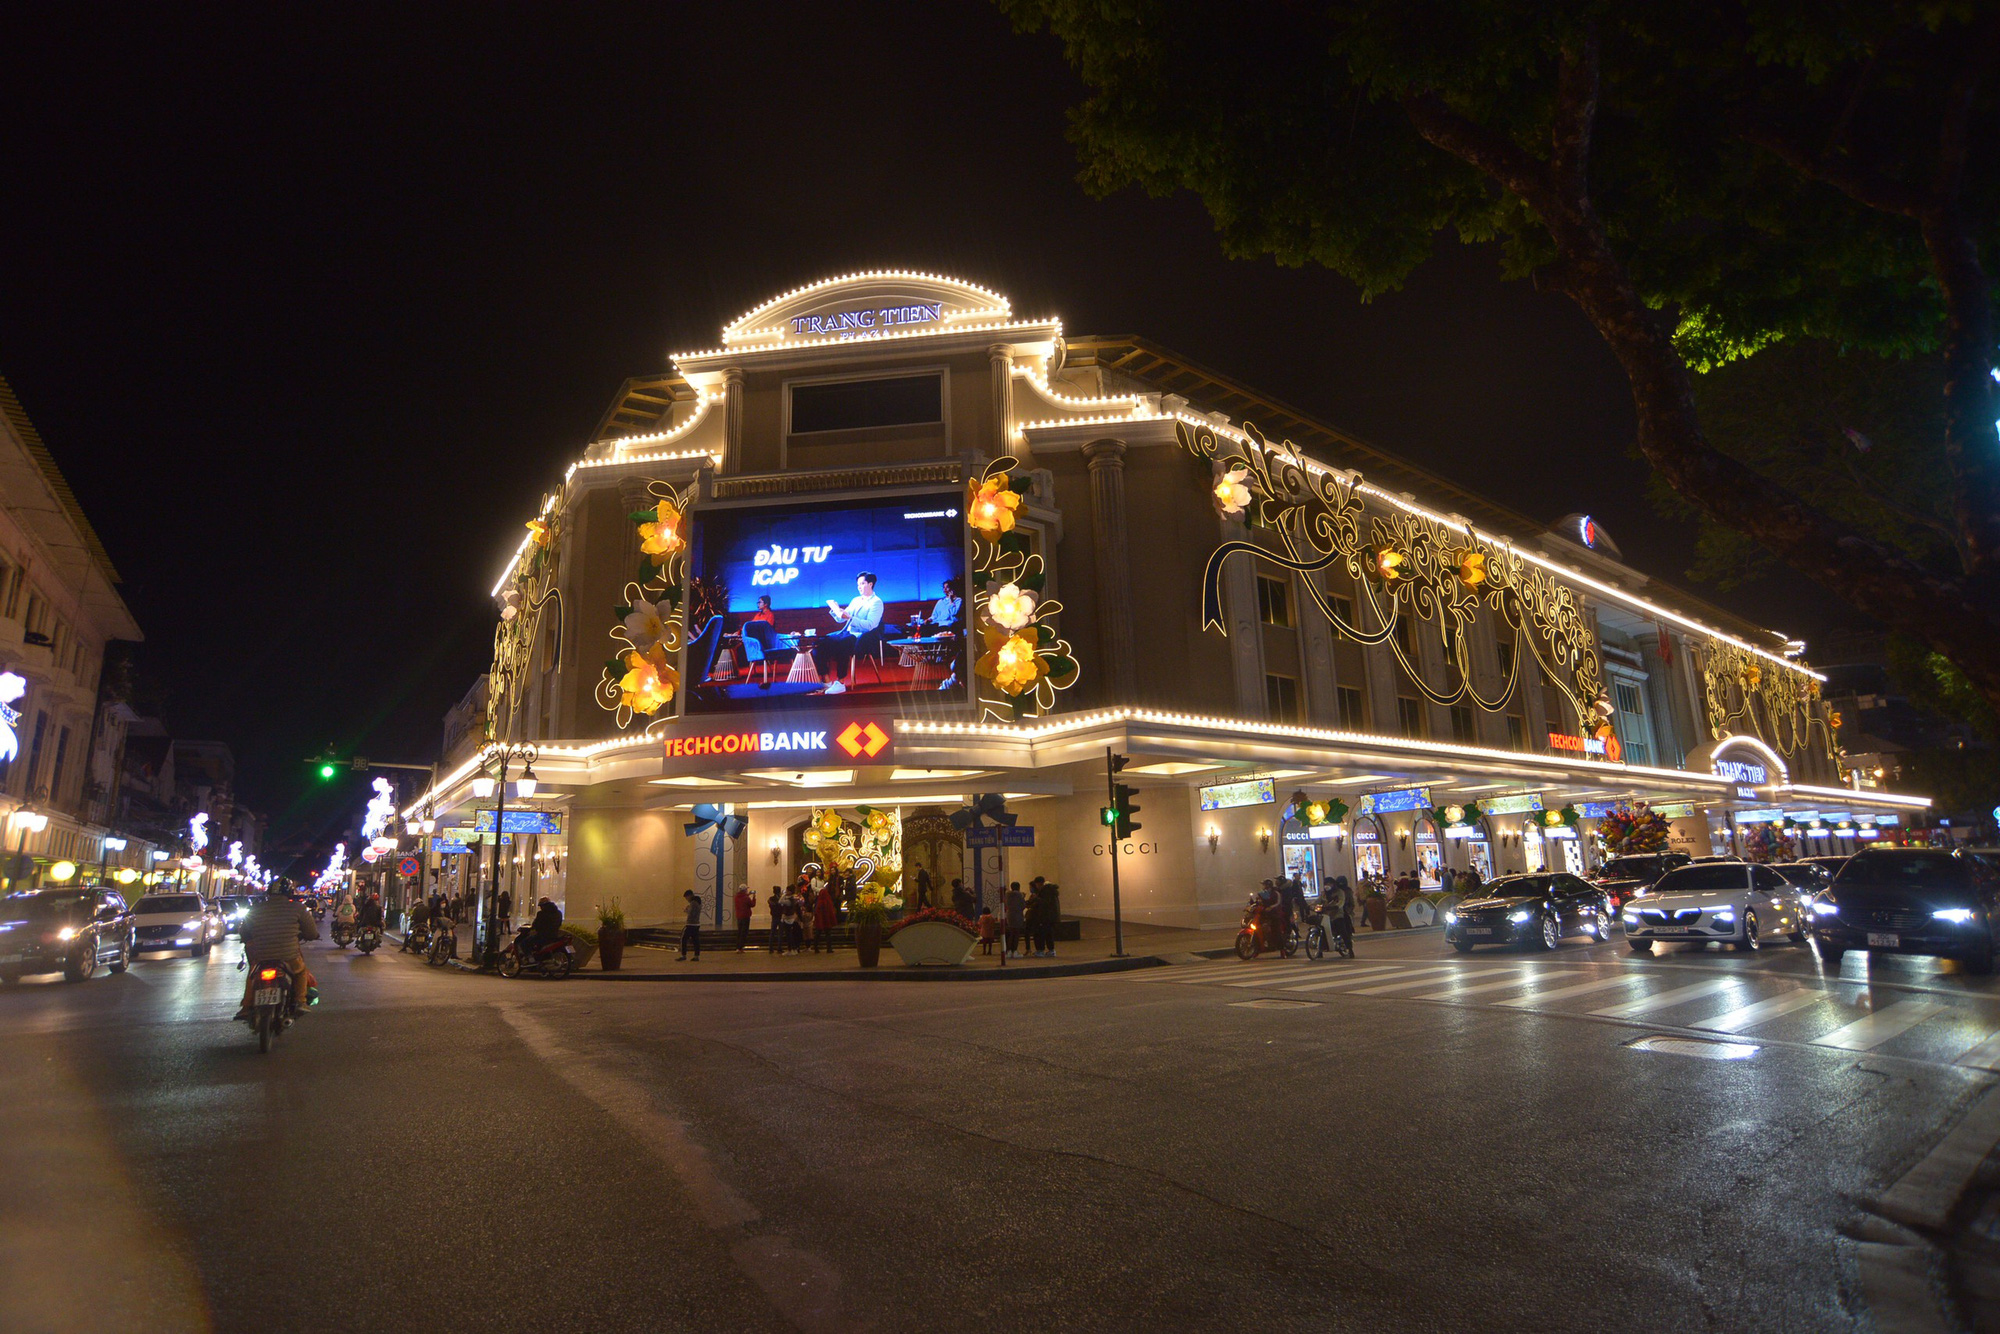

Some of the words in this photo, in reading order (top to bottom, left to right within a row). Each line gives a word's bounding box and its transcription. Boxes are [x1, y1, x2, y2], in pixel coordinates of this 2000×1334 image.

[791, 311, 875, 334] TRANG
[880, 303, 942, 326] TIEN
[754, 544, 798, 566] ĐẦU
[802, 545, 833, 563] TƯ
[752, 568, 799, 586] iCAP
[664, 731, 827, 757] TECHCOMBANK
[1549, 733, 1606, 754] TECHCOMBANK
[1717, 760, 1747, 782] TRANG
[1287, 832, 1309, 840] GUCCI
[1356, 832, 1376, 840] GUCCI
[1092, 842, 1158, 856] GUCCI
